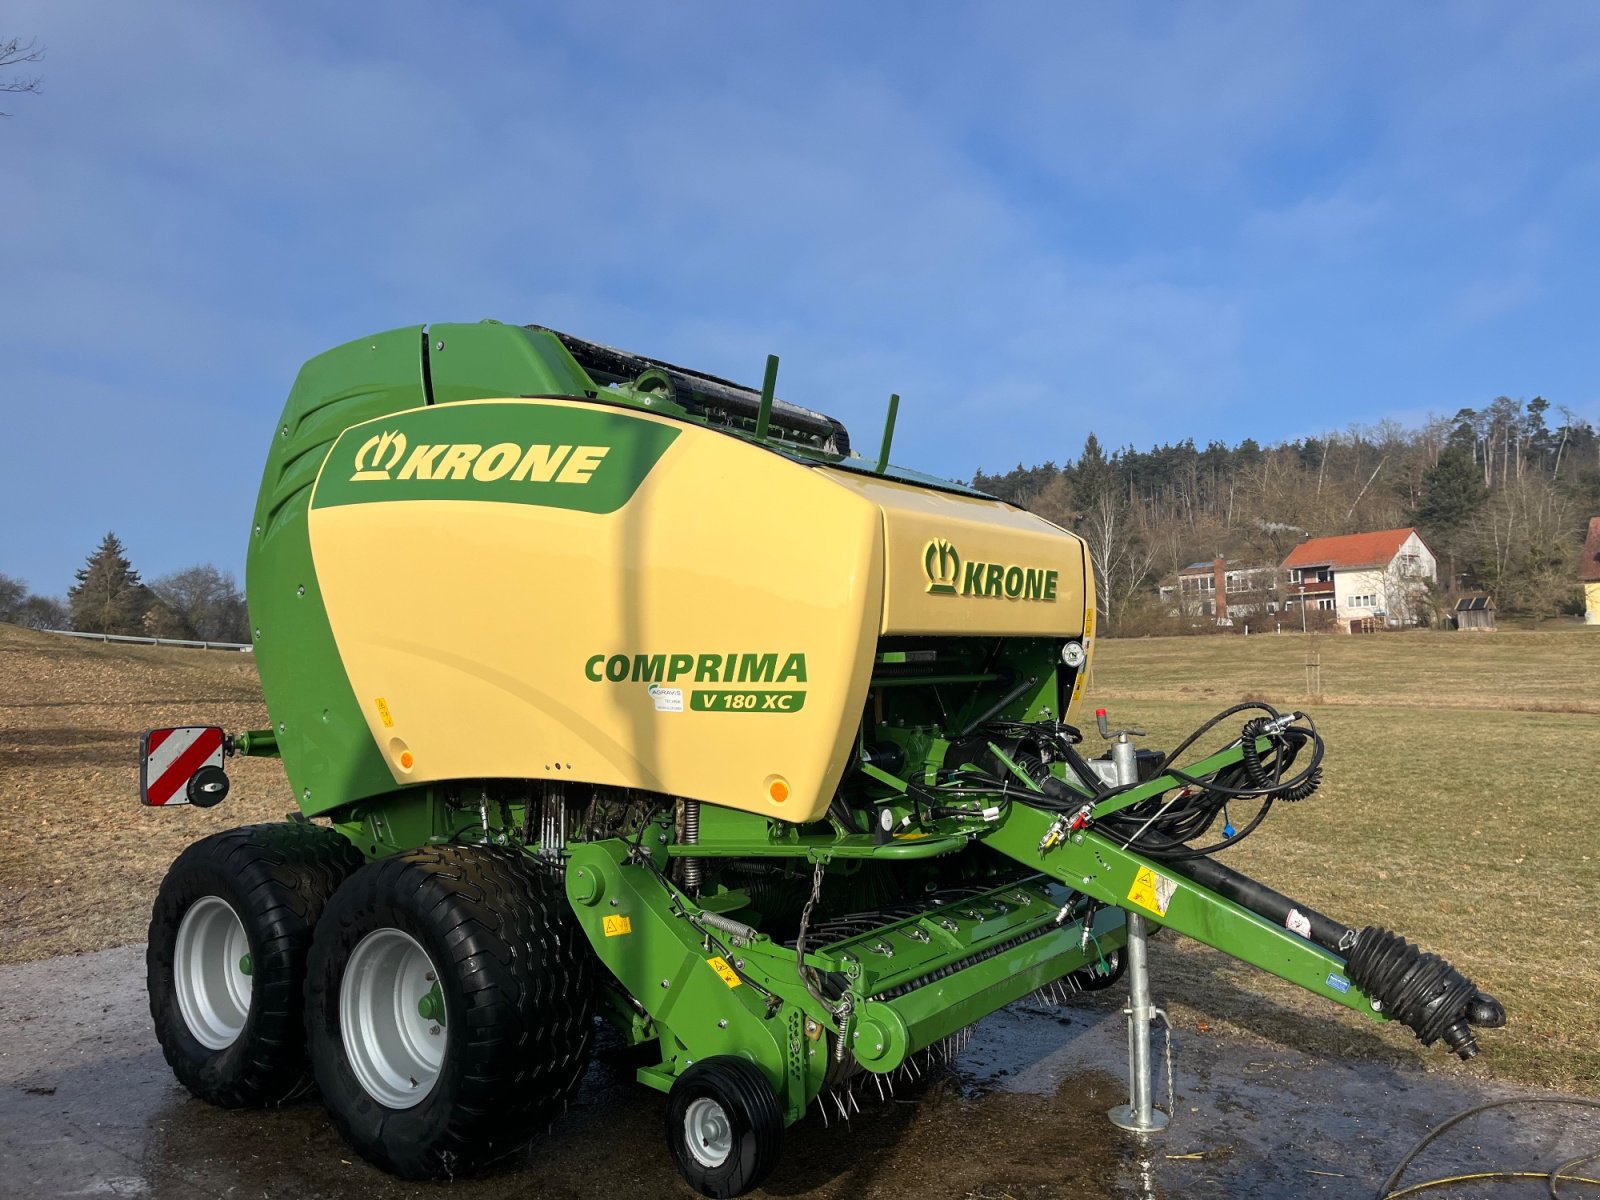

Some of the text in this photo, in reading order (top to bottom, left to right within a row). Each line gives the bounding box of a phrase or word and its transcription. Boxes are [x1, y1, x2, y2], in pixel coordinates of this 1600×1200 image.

[396, 442, 611, 484] KRONE
[961, 561, 1058, 601] KRONE
[585, 653, 808, 683] COMPRIMA
[703, 694, 793, 710] V 180 XC
